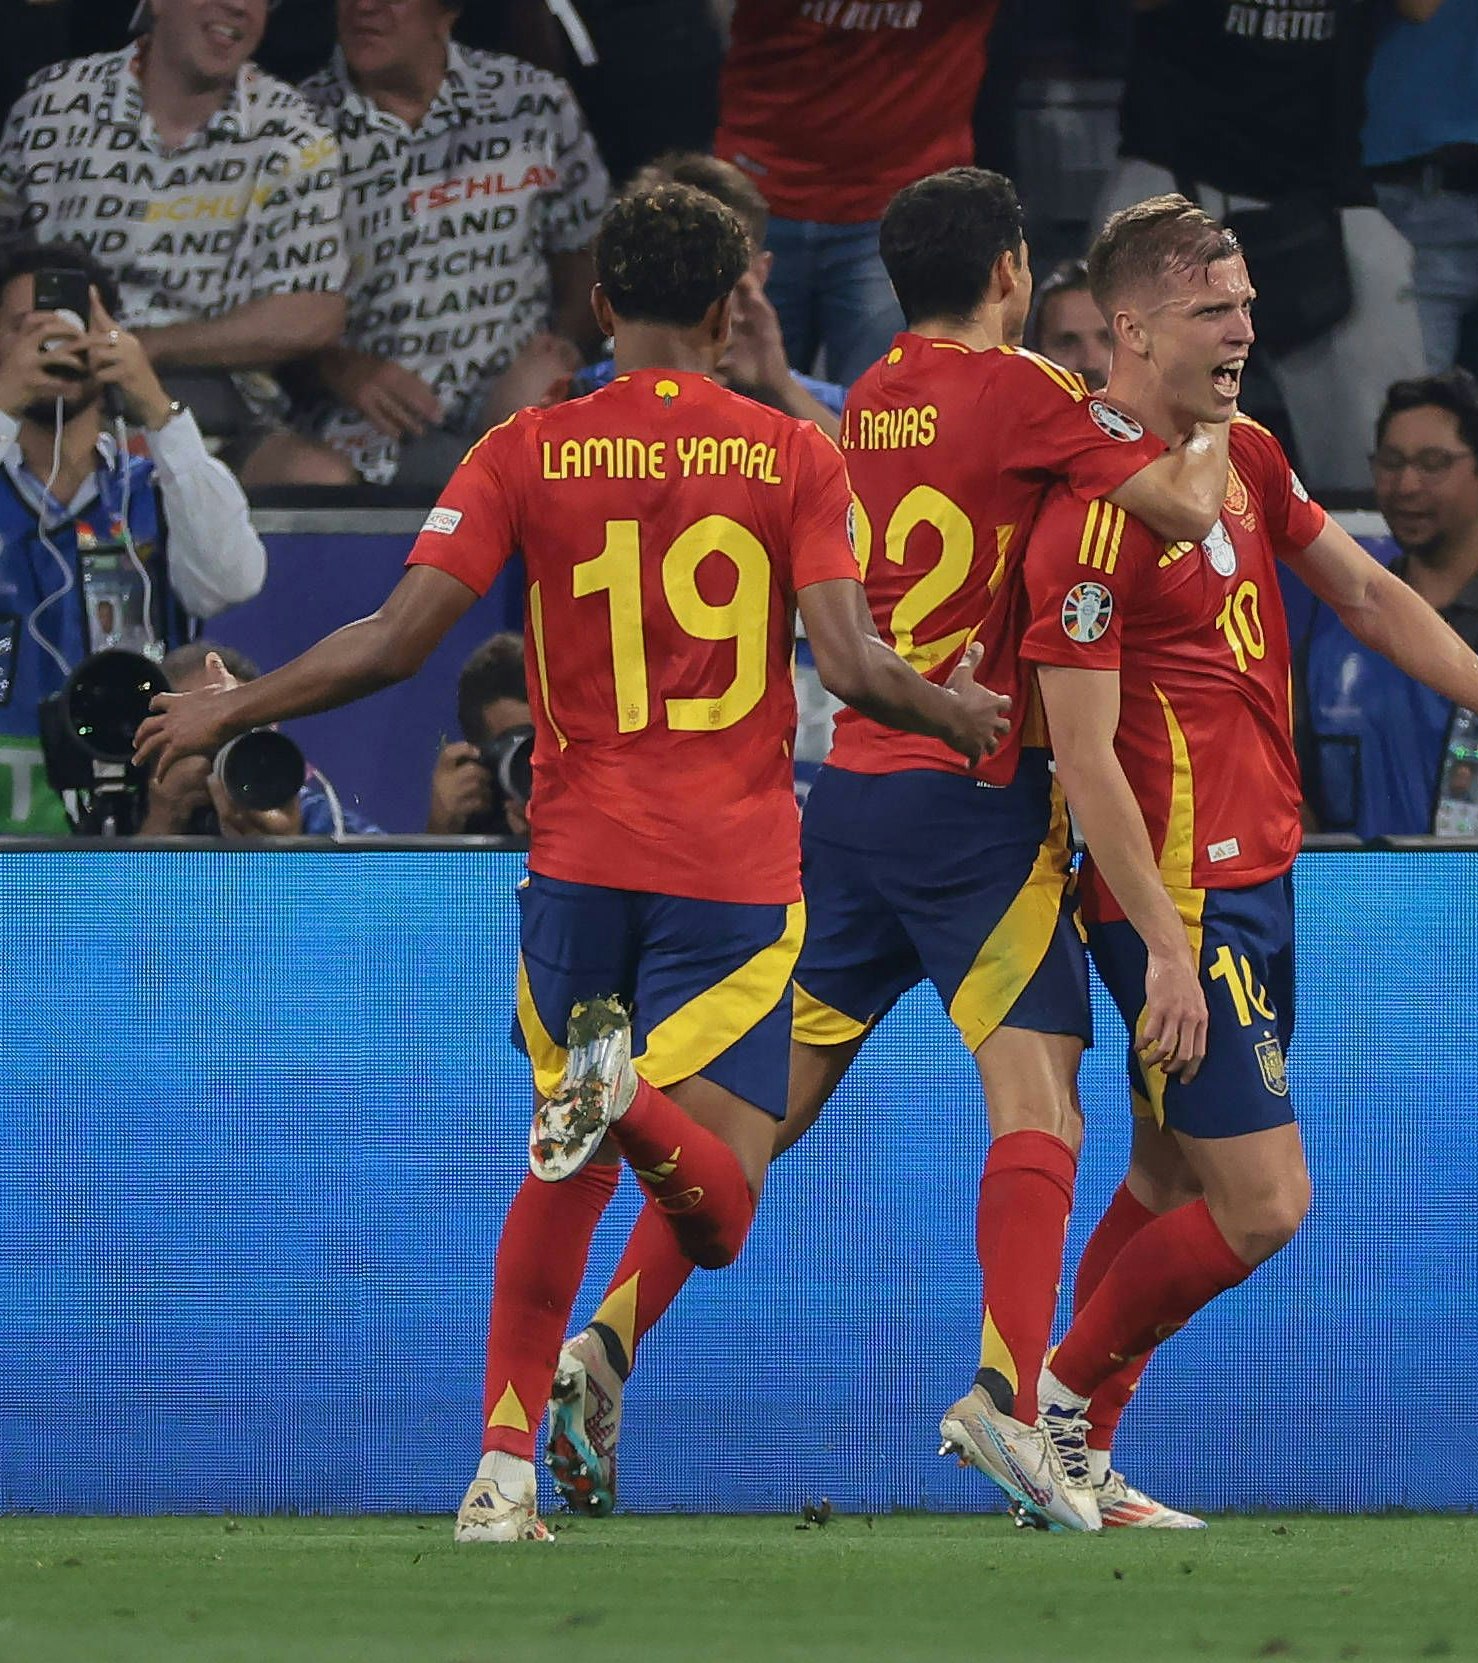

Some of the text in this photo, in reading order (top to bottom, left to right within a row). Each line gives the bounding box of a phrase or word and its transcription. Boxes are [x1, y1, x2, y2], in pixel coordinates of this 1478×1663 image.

[543, 436, 782, 485] LAMINE YAMAL
[842, 404, 938, 450] J. NAVAS
[573, 514, 771, 734] 19
[1216, 580, 1265, 673] 10
